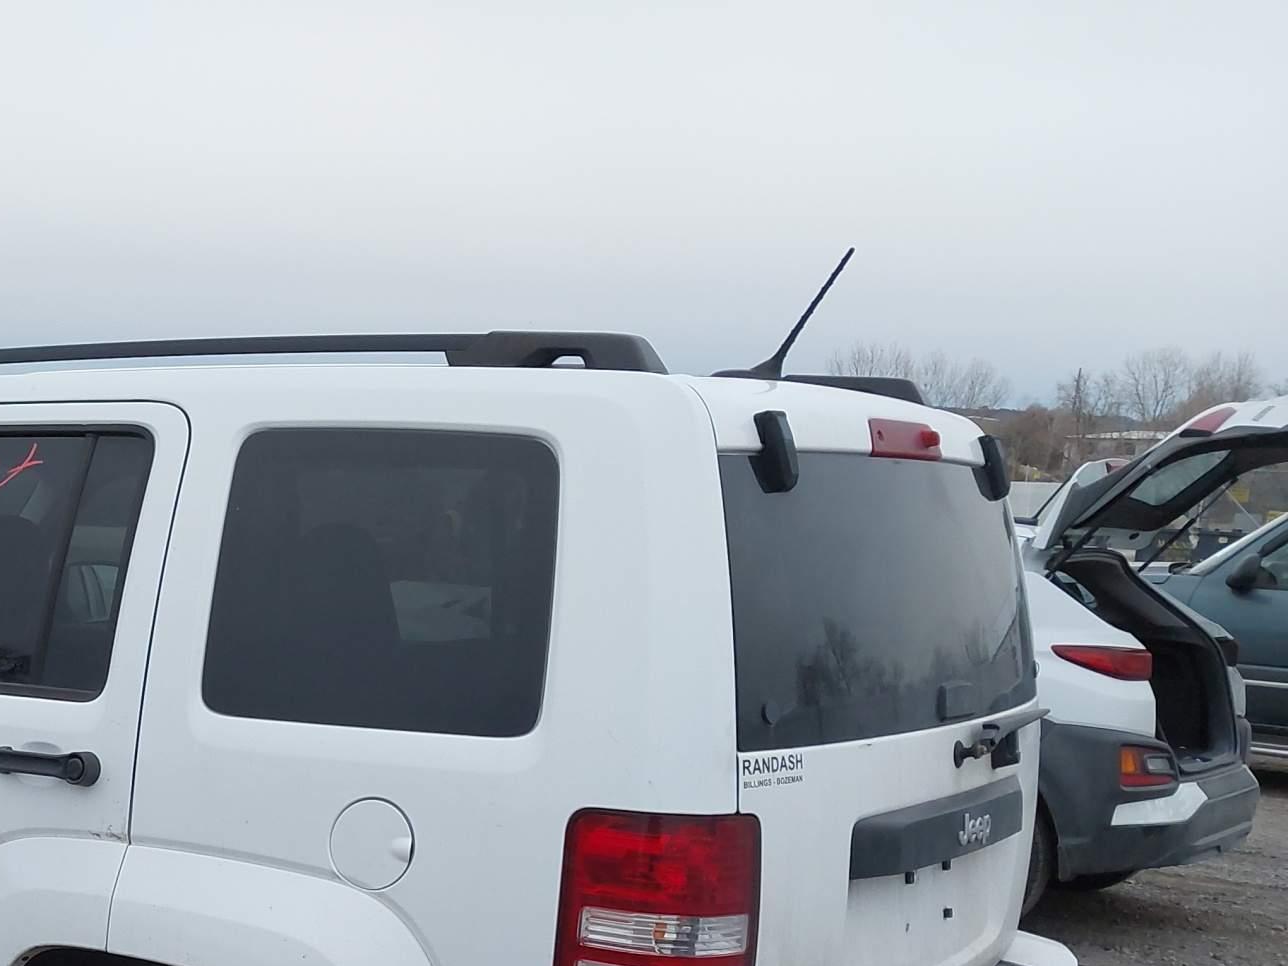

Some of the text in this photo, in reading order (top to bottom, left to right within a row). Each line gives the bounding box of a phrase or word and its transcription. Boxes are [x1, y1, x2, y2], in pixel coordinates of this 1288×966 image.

[742, 753, 803, 776] RANDASH
[743, 779, 772, 789] BILLINGS
[958, 813, 992, 846] Jeep
